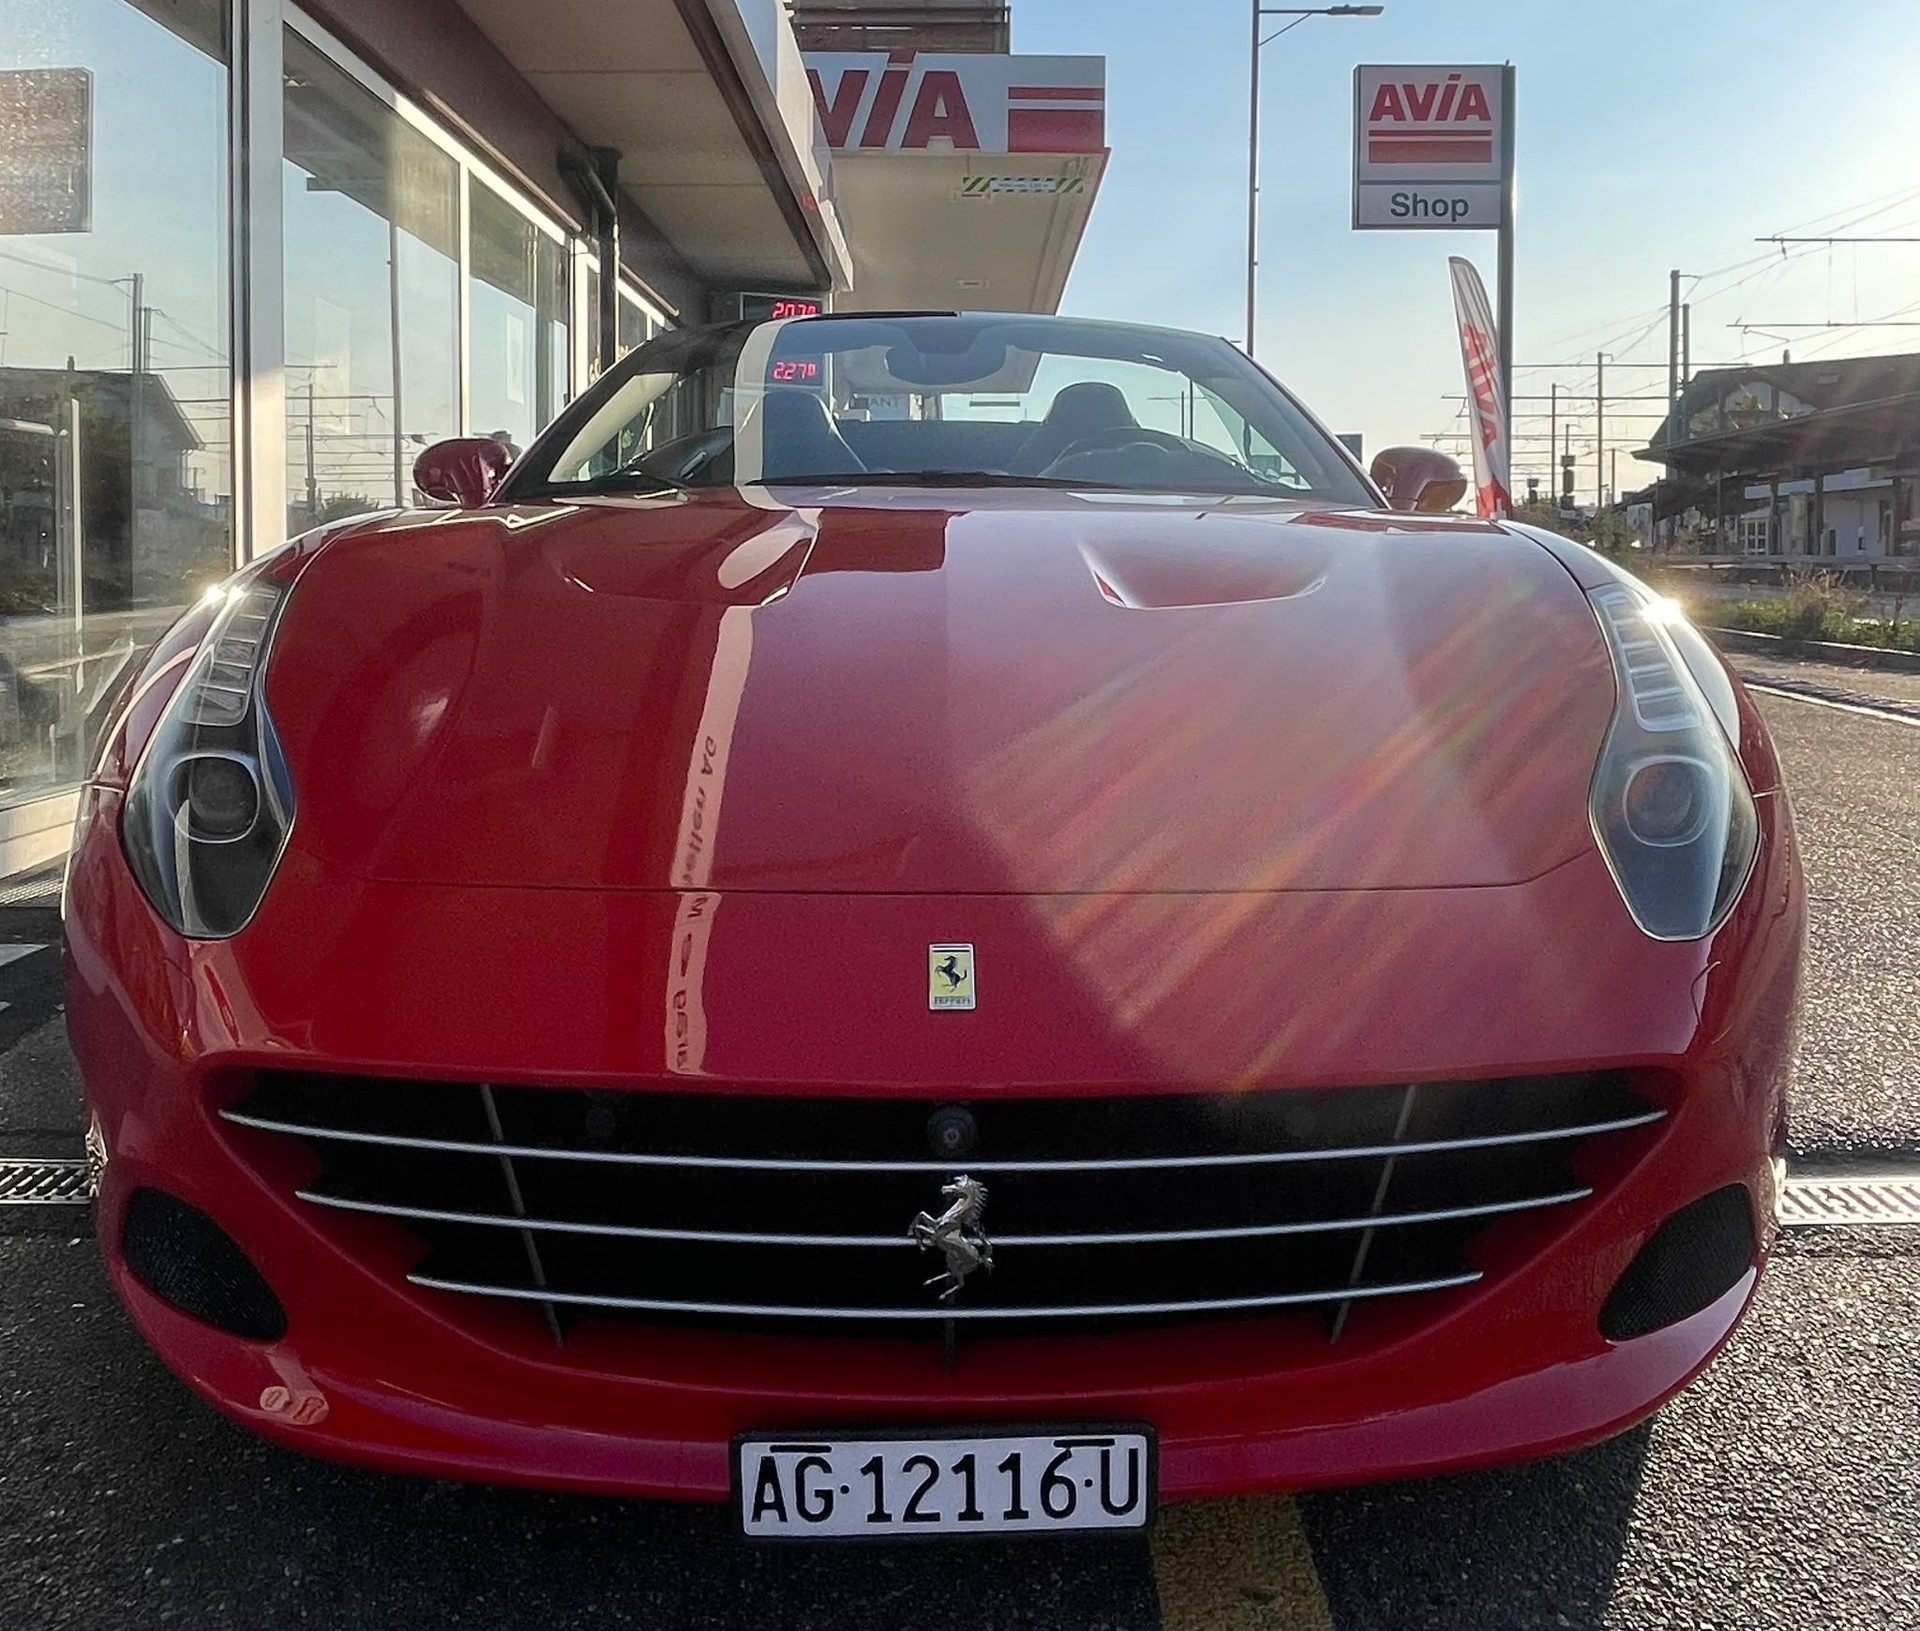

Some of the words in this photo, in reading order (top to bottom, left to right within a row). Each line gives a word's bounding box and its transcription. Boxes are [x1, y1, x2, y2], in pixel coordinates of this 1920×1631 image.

[806, 51, 980, 149] VIA
[1369, 74, 1492, 121] AVIA
[1390, 192, 1469, 222] Shop
[773, 362, 817, 380] 2270
